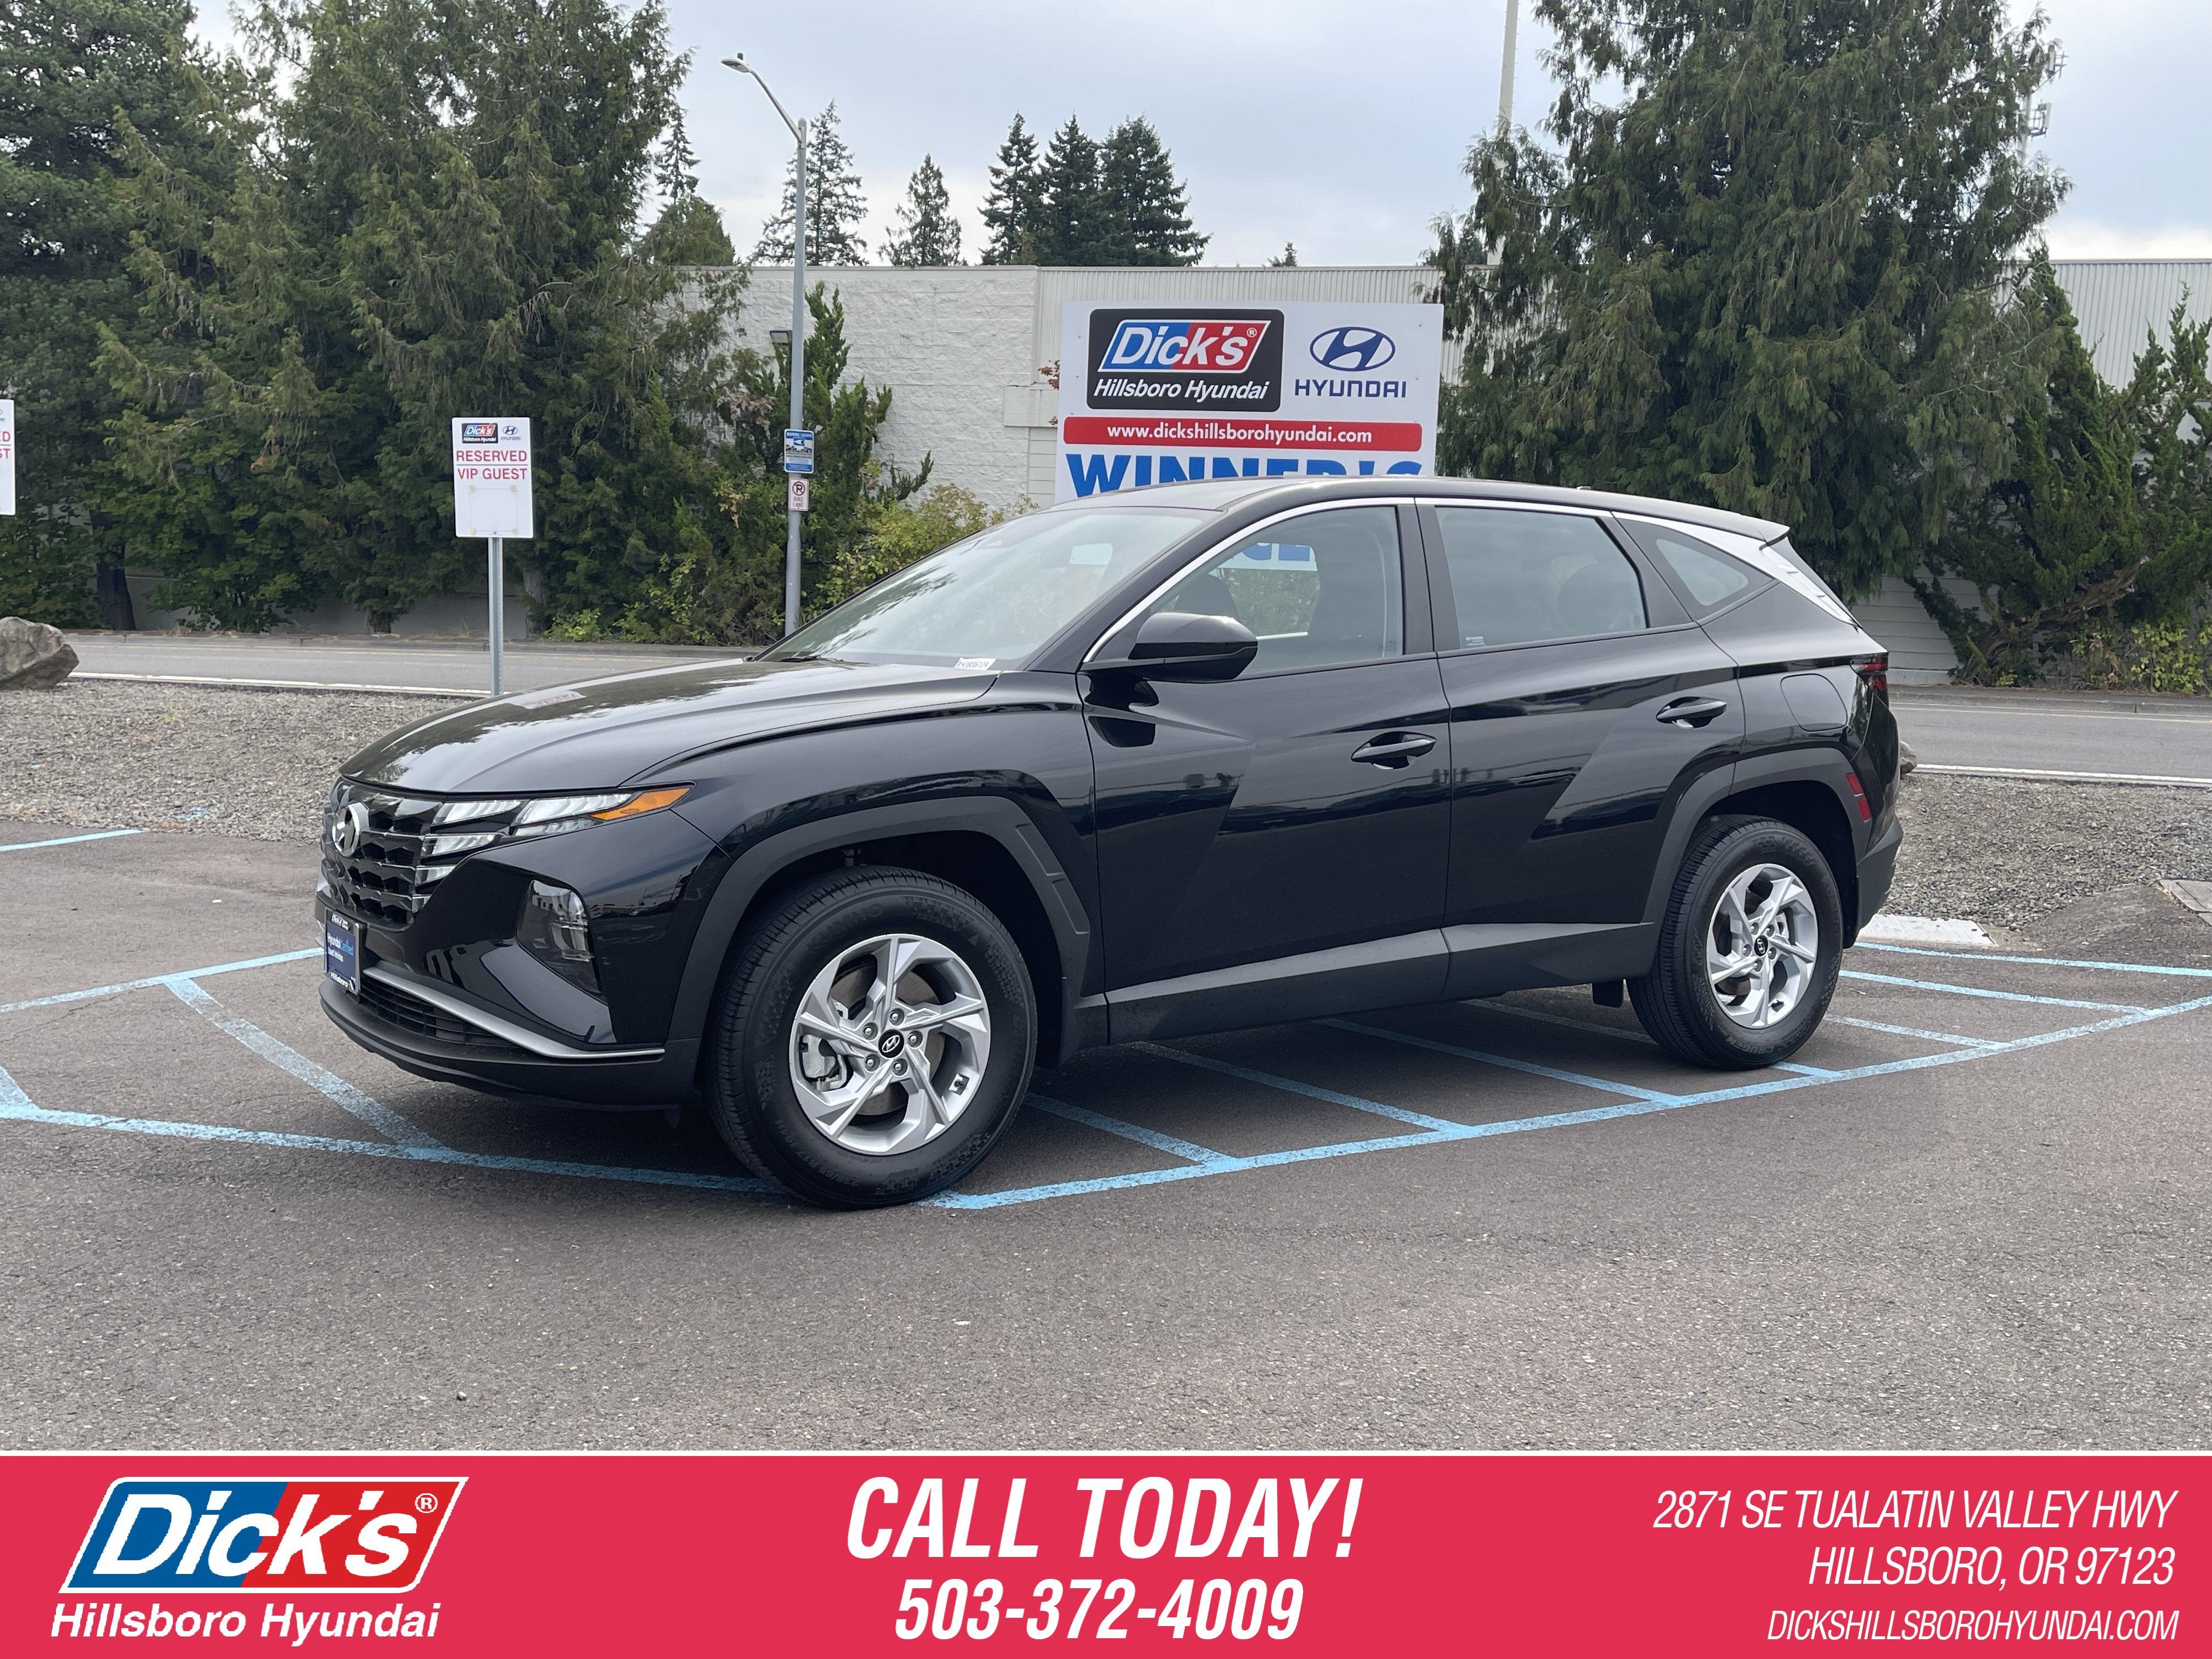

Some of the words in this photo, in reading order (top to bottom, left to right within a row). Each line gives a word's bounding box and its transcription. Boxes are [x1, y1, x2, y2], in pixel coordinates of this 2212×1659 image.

[1110, 325, 1248, 366] Dick's
[1093, 379, 1182, 397] Hillsboro
[1184, 380, 1270, 403] Hyundai
[1295, 379, 1406, 398] HYUNDAI
[466, 425, 493, 435] Dick's
[1107, 422, 1372, 443] www.dickshillsborohyundai.com
[456, 450, 527, 461] RESERVED
[458, 468, 478, 479] VIP
[483, 468, 527, 479] GUEST
